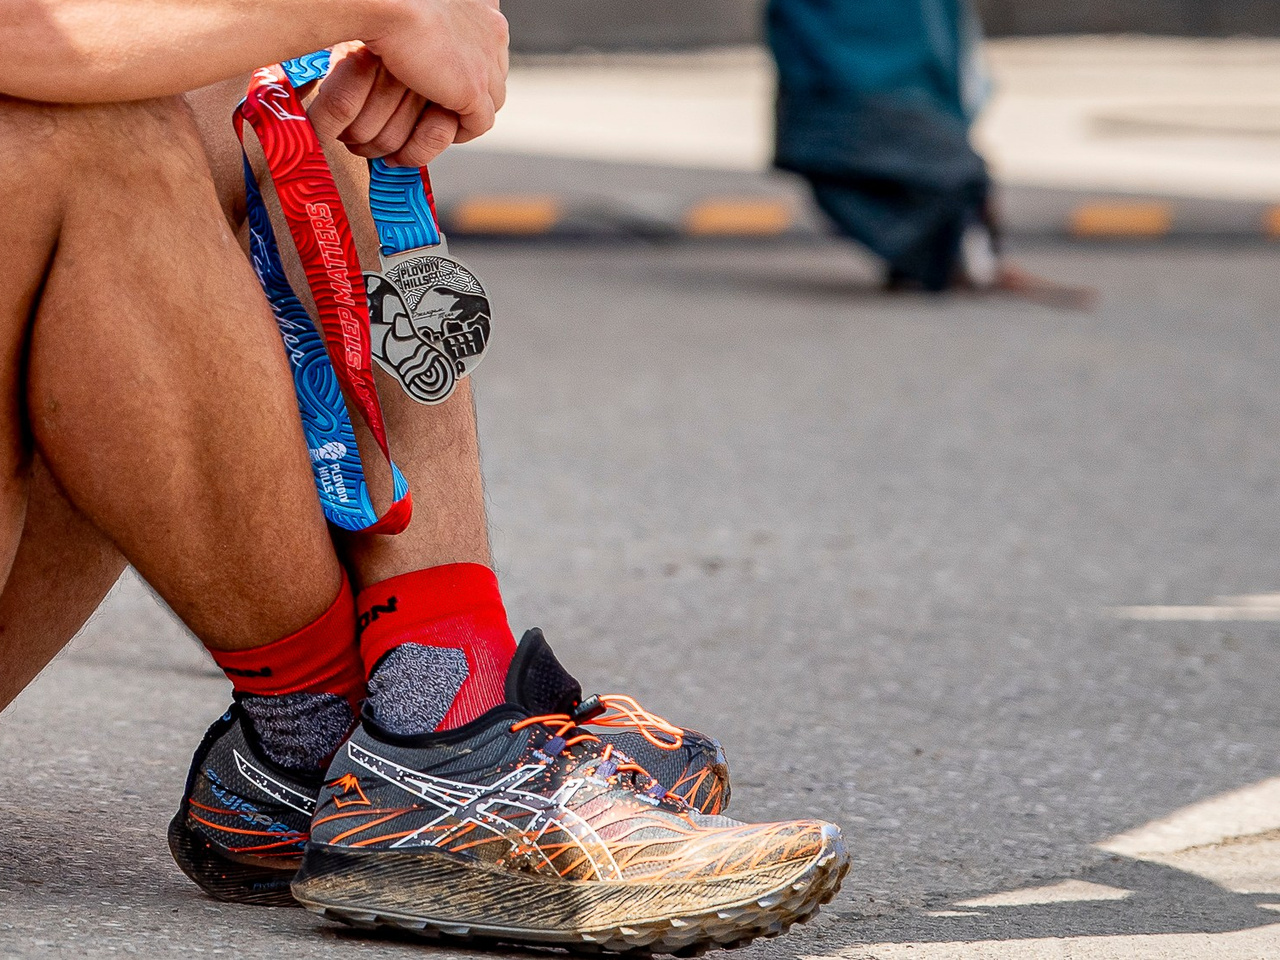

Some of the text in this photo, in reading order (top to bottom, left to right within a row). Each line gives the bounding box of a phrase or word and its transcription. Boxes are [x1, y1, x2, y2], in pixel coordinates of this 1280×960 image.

[305, 201, 356, 307] MATTERS
[400, 260, 440, 279] PLOVDIV
[403, 275, 431, 290] HILLS
[337, 307, 363, 371] STEP
[318, 466, 334, 494] HILLS
[330, 462, 350, 504] PLOVDIV
